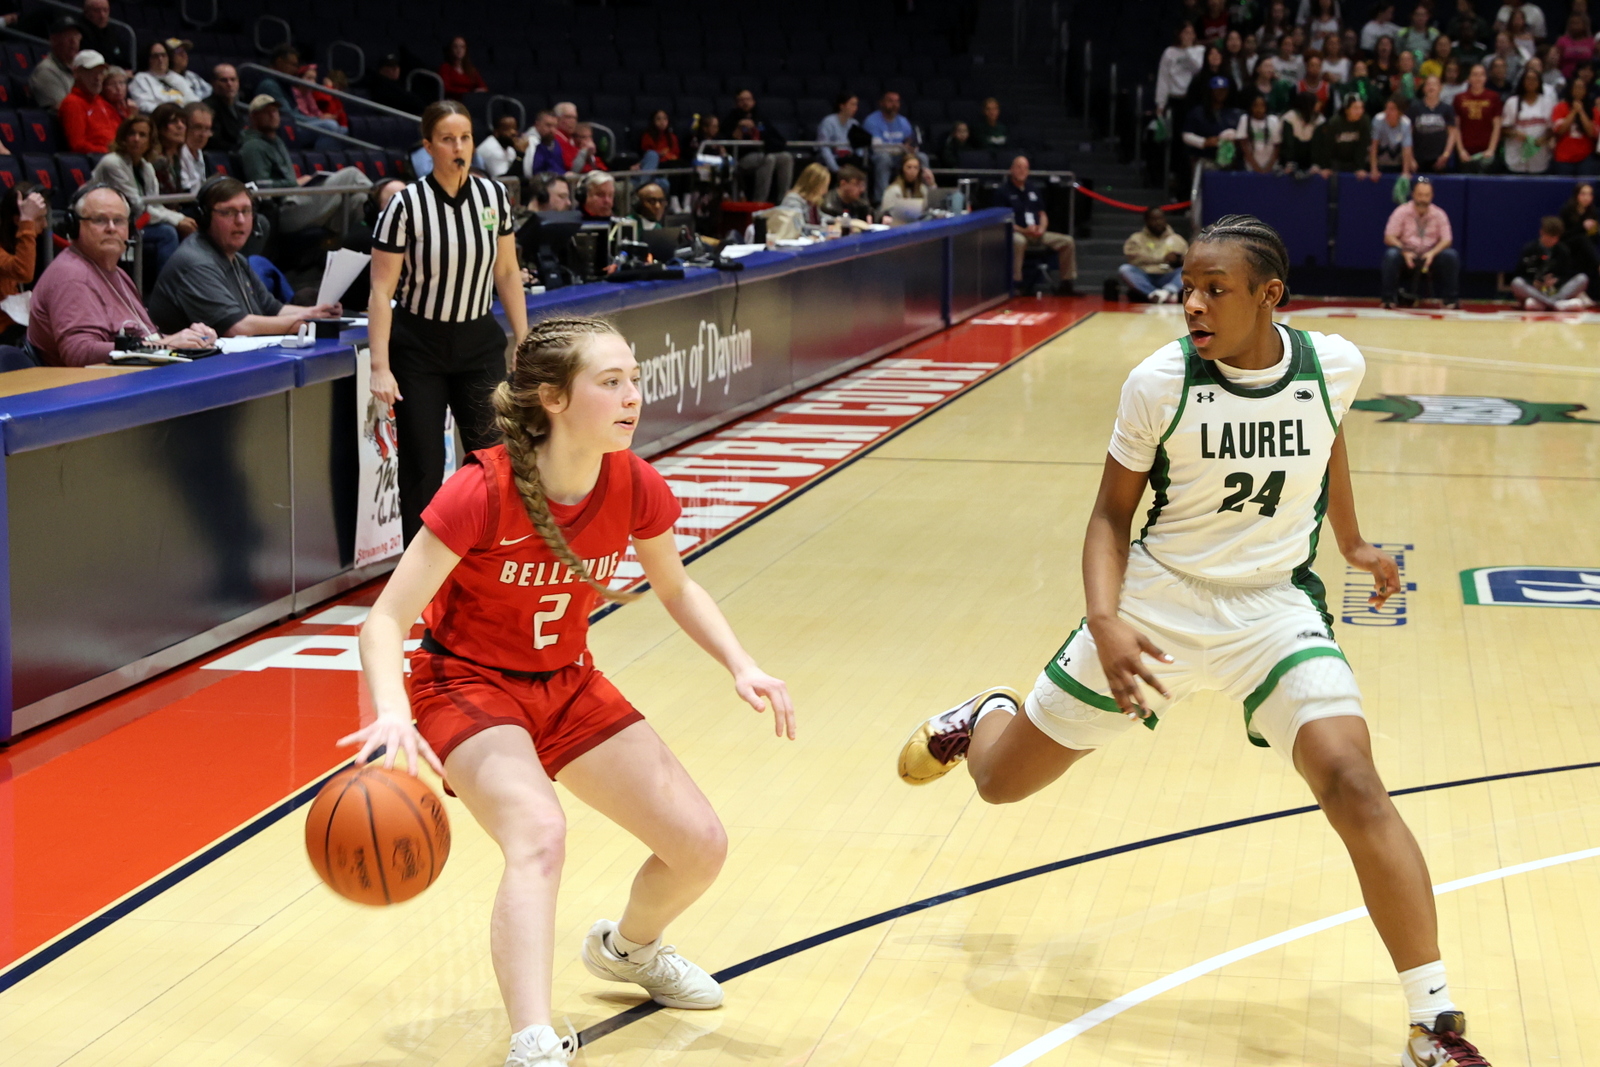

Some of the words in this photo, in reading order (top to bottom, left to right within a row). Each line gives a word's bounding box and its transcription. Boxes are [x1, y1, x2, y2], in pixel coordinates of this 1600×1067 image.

[689, 319, 705, 406] of
[707, 322, 752, 395] Dayton
[772, 358, 1000, 417] COURT
[1201, 419, 1310, 459] LAUREL
[1217, 470, 1286, 518] 24
[533, 592, 571, 650] 2
